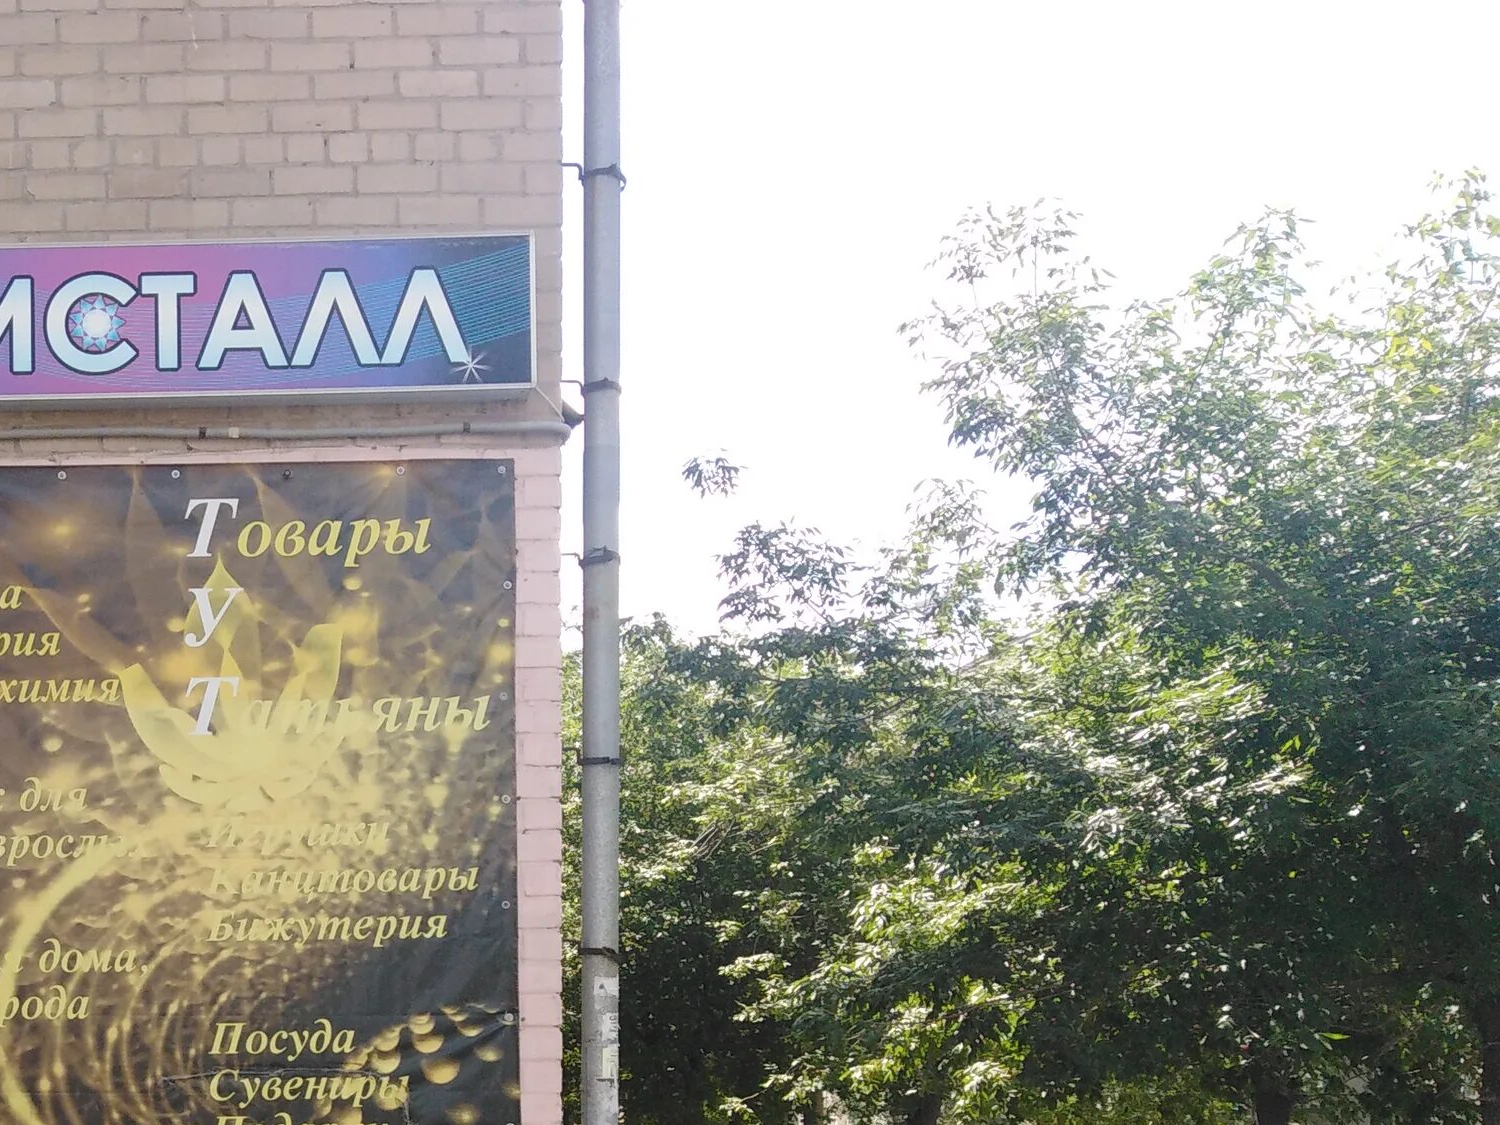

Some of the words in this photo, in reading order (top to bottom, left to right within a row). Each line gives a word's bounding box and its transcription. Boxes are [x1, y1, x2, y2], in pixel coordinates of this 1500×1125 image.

[184, 498, 432, 567] Товары
[19, 777, 88, 813] для
[209, 864, 480, 904] Канцтовары
[206, 910, 449, 948] Бижутерия
[38, 938, 151, 978] дома,
[208, 1018, 358, 1062] Посуда
[209, 1068, 410, 1109] Сувениры
